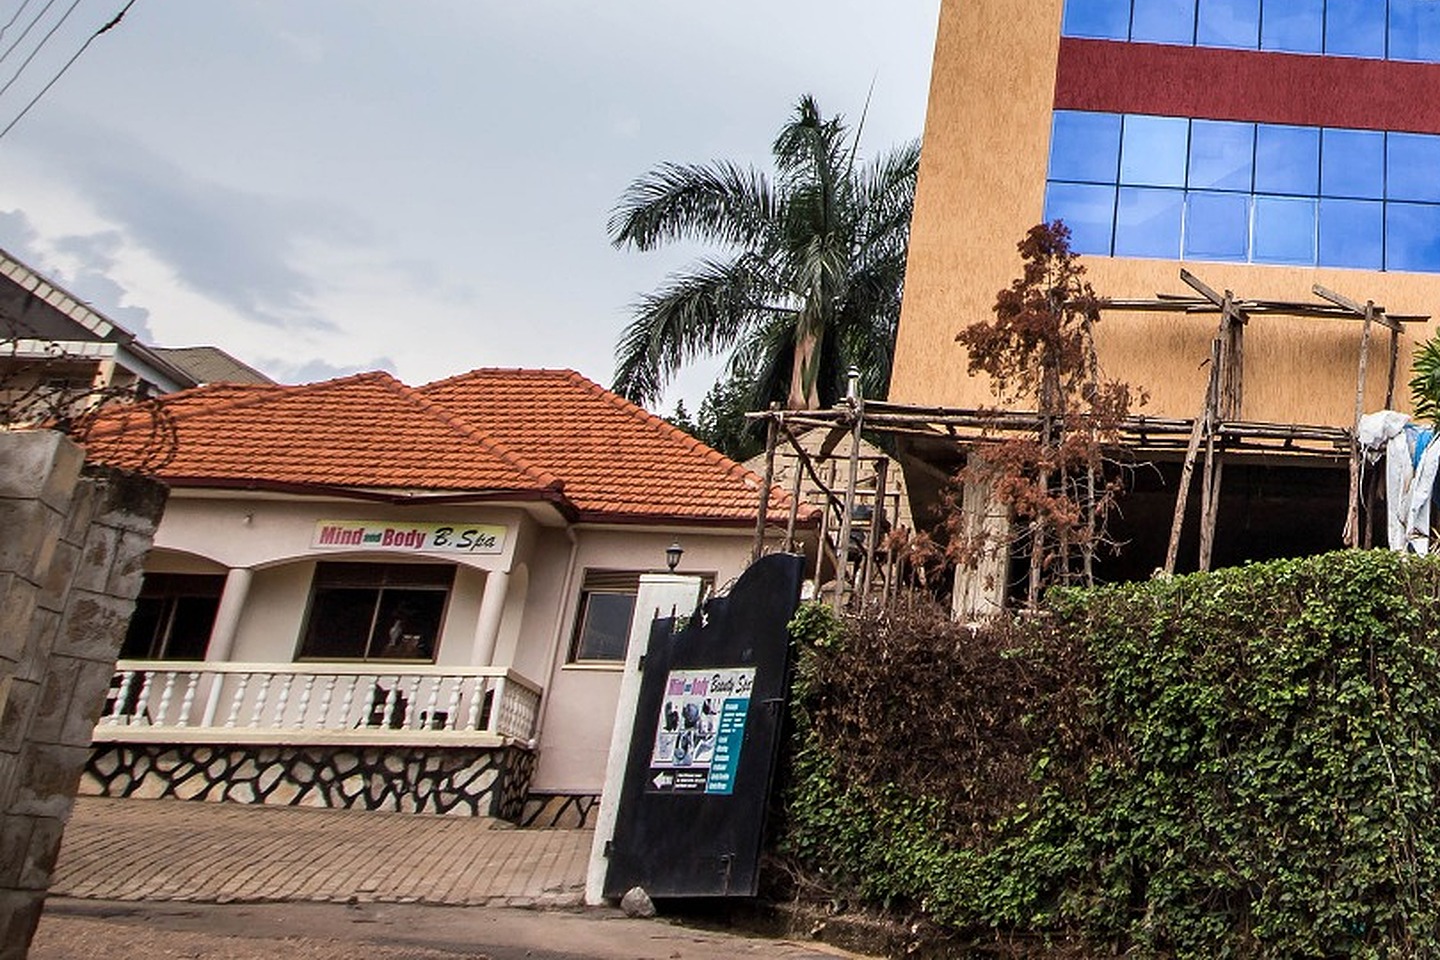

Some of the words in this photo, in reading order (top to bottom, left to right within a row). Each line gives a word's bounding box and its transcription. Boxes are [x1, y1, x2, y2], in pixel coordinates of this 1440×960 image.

[319, 526, 364, 545] Mind
[382, 528, 426, 549] Body
[456, 530, 495, 551] Spa
